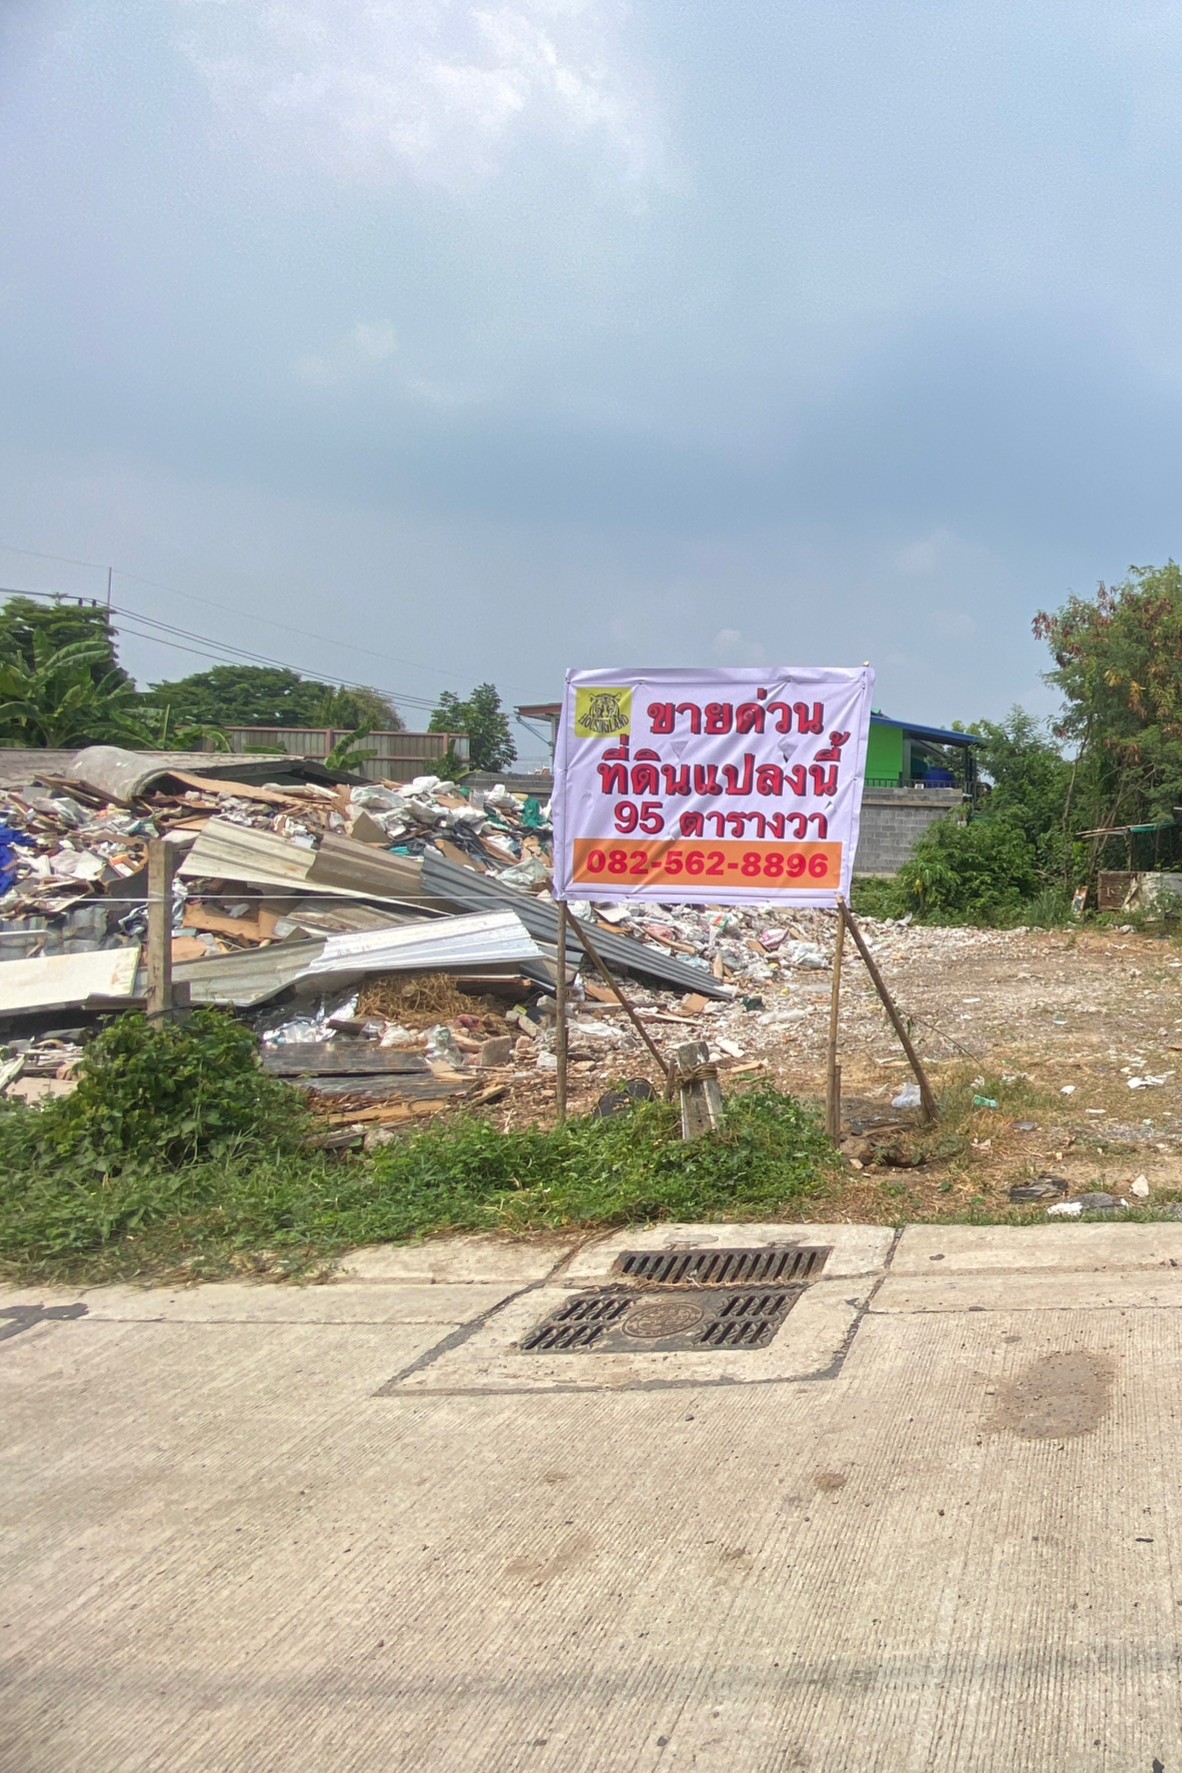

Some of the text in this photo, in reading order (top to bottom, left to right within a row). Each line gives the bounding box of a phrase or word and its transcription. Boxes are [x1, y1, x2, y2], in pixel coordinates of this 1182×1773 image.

[647, 688, 824, 734] ขายด่วน
[597, 731, 851, 796] ที่ดินแปลงนี้
[614, 801, 828, 840] 95 ตารางวา
[586, 848, 828, 878] 082-562-8896
